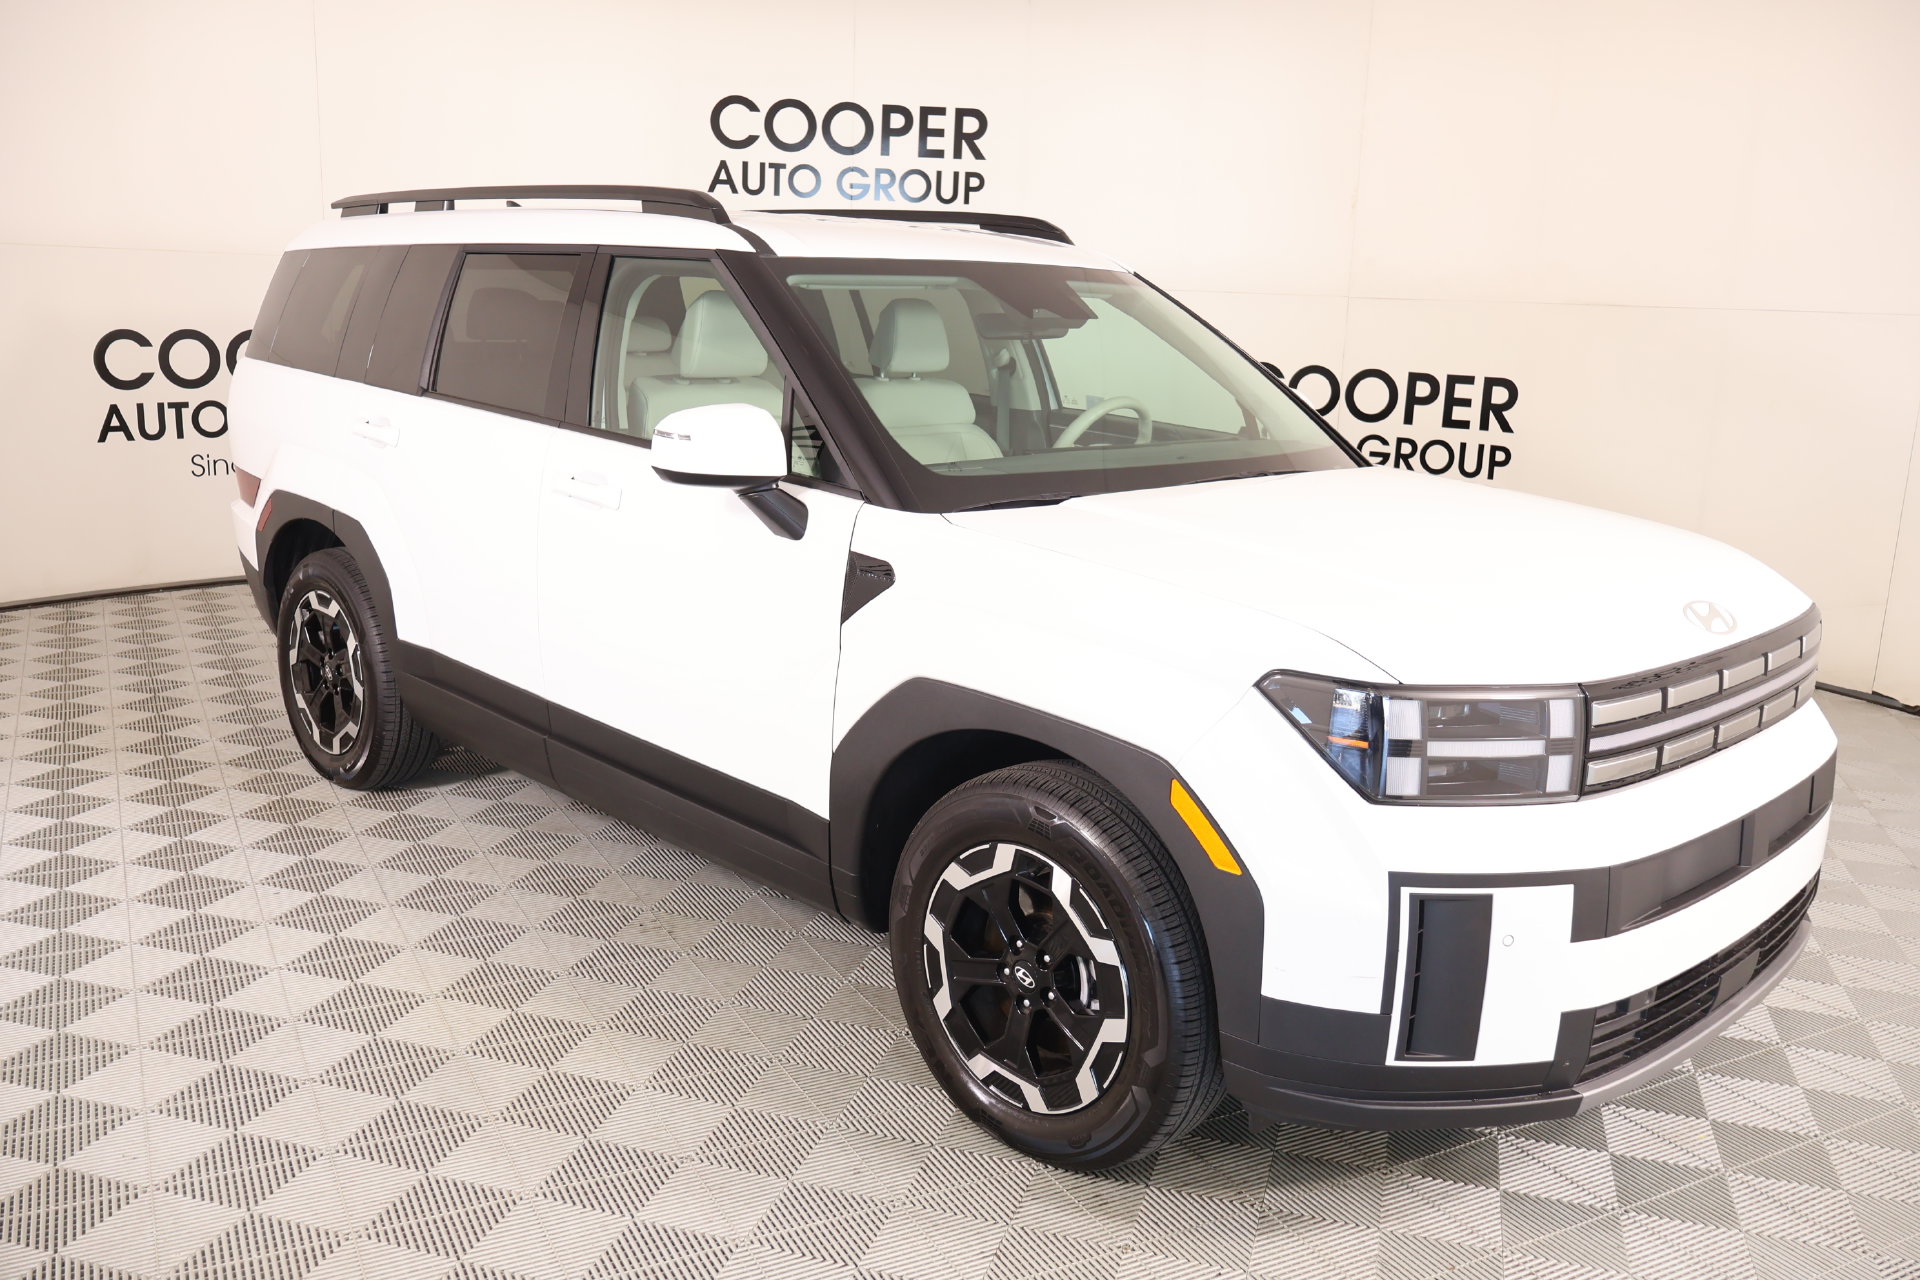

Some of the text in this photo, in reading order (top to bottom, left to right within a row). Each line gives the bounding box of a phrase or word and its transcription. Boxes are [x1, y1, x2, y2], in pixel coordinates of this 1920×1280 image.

[709, 94, 988, 161] COOPER
[707, 159, 986, 205] AUTO GROUP
[97, 399, 229, 444] AUTO
[1259, 361, 1520, 434] OOPER
[1356, 433, 1513, 481] GROUP
